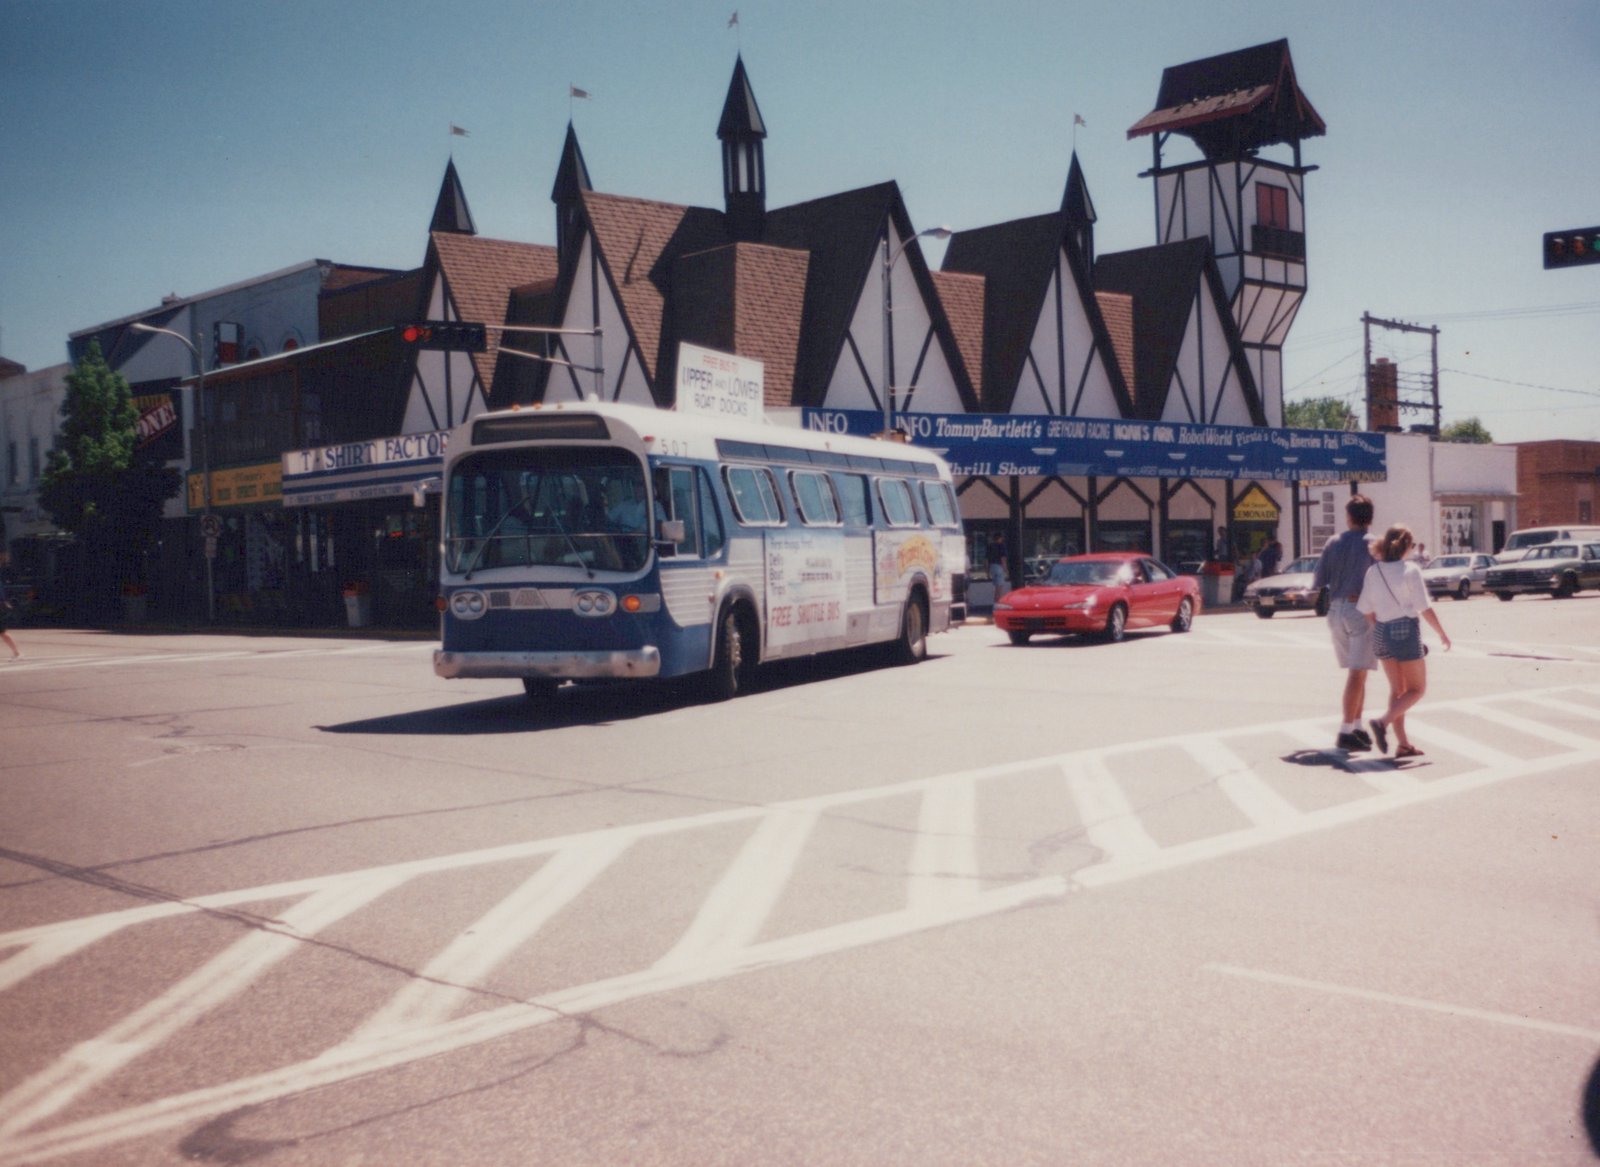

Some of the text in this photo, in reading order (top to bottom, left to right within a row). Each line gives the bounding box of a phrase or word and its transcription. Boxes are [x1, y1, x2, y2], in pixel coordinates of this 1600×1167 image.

[682, 366, 713, 391] UPPER
[728, 377, 760, 401] LOWER
[720, 397, 748, 417] DOCKS
[808, 412, 849, 434] INFO
[896, 416, 931, 437] INFO
[1047, 420, 1086, 439] GREYHOUND
[660, 438, 689, 457] 507
[1236, 429, 1269, 446] Pirate's
[301, 451, 311, 471] T
[325, 443, 377, 468] SHIRT
[997, 462, 1041, 475] Show
[771, 605, 793, 628] FREE
[827, 600, 841, 621] BUS
